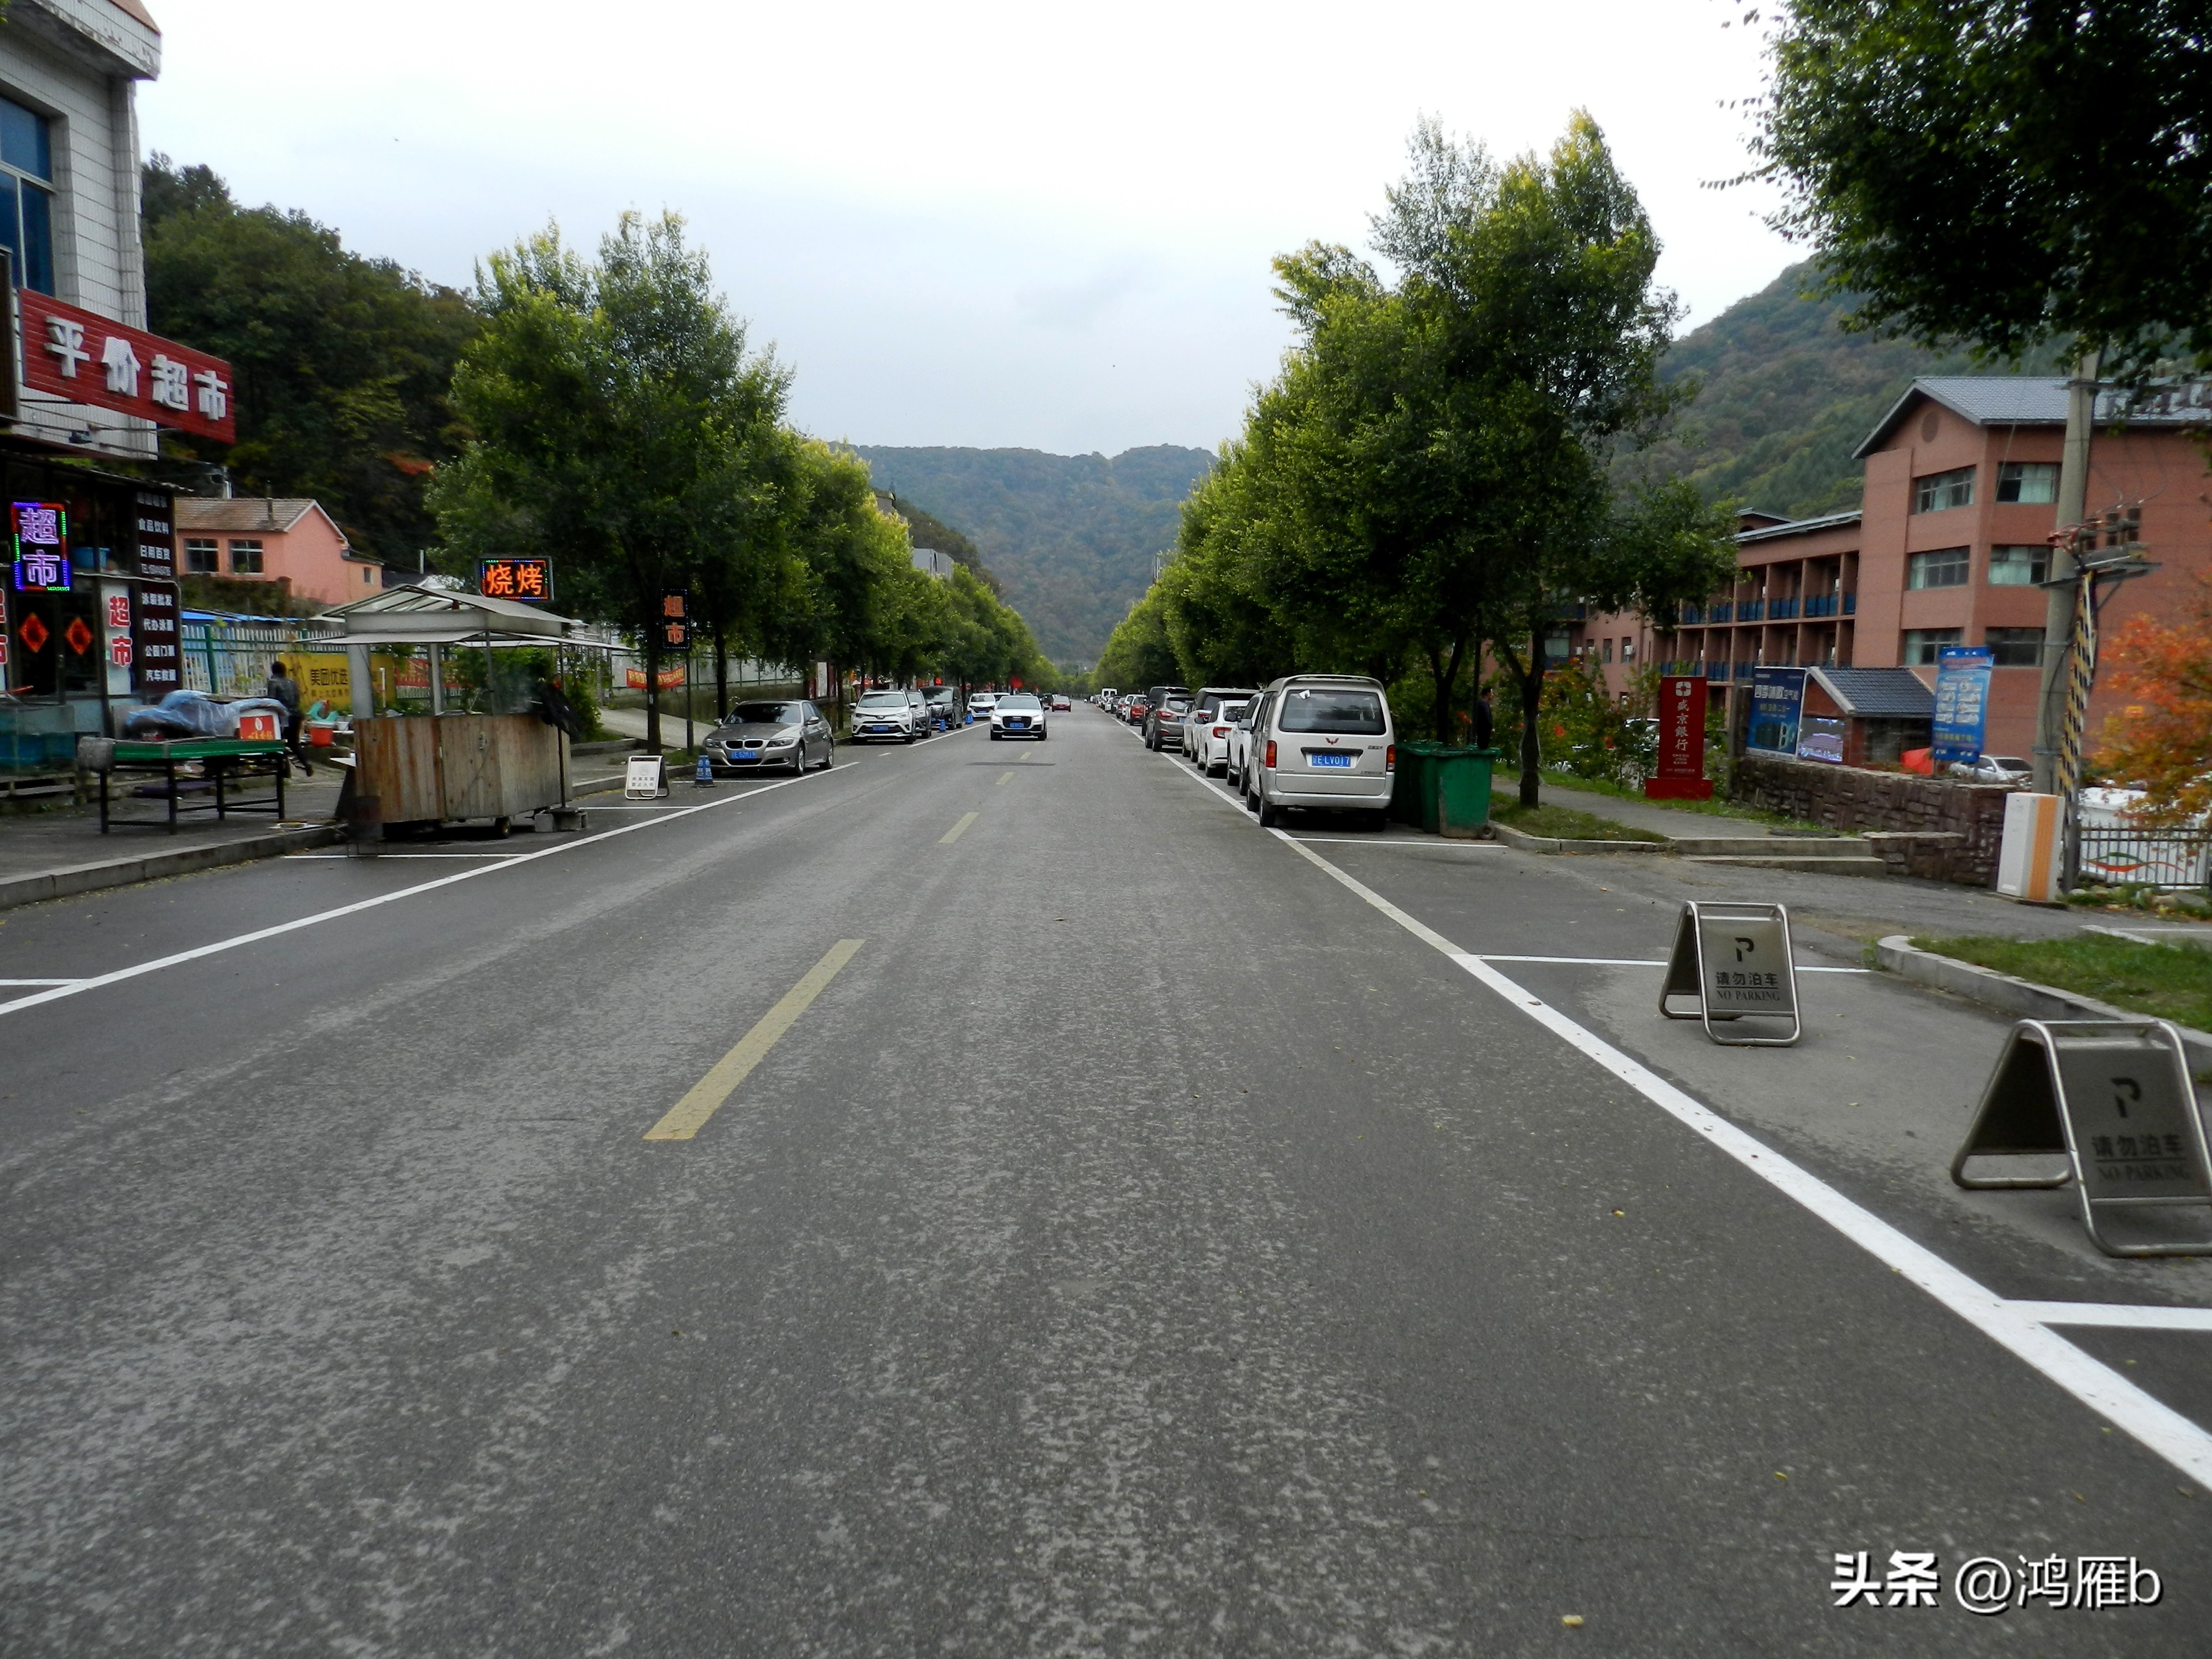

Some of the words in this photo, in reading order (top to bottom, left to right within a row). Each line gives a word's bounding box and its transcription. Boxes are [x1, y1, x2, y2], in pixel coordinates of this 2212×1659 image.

[45, 316, 228, 421] 平价超市
[18, 507, 59, 586] 超市
[486, 565, 543, 595] 烧烤
[109, 596, 133, 666] 超市
[664, 594, 685, 645] 超市
[1716, 972, 1778, 986] 请勿泊车
[1717, 991, 1731, 1000] NO
[1736, 991, 1780, 1001] PARKING
[2091, 1134, 2184, 1157] 请勿泊车
